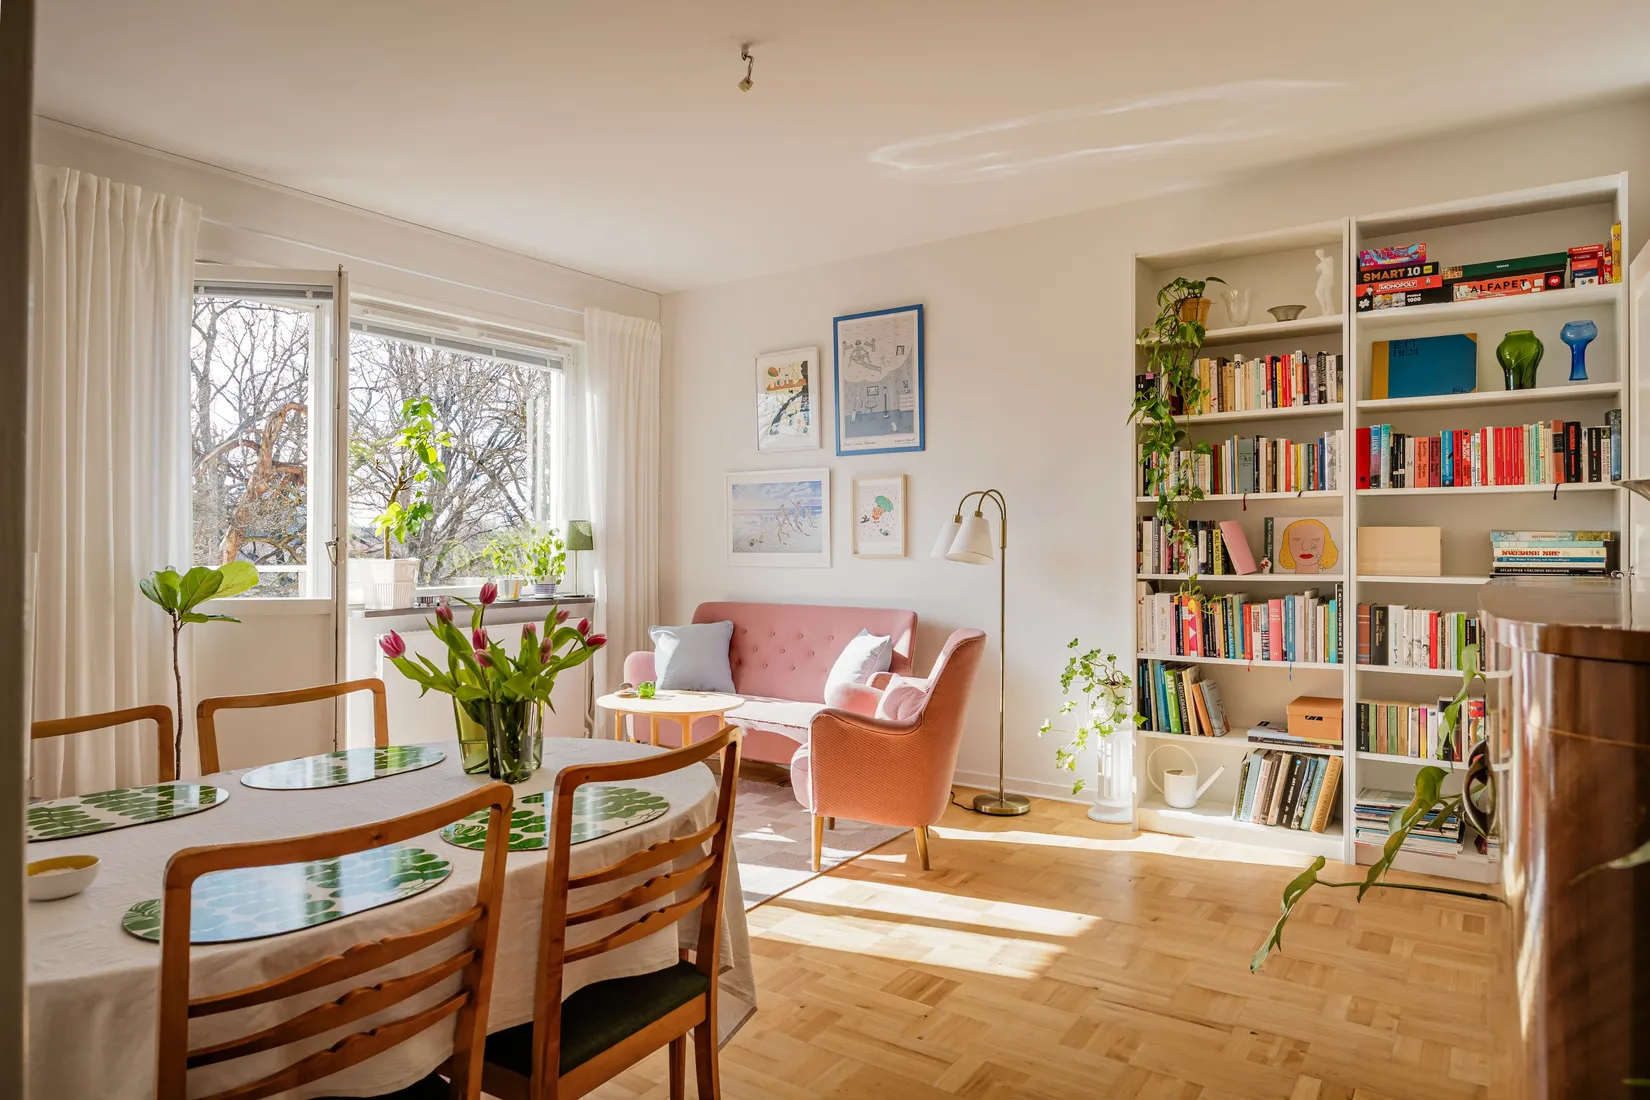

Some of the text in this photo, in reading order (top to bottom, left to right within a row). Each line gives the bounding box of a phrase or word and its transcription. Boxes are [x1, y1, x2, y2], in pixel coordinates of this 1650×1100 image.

[1363, 266, 1420, 282] SMART 10
[1380, 280, 1417, 291] MONOPOLY
[1470, 278, 1527, 293] ALFAPET
[1394, 340, 1418, 349] ETT
[1393, 348, 1419, 357] HEM
[1166, 674, 1176, 695] ART
